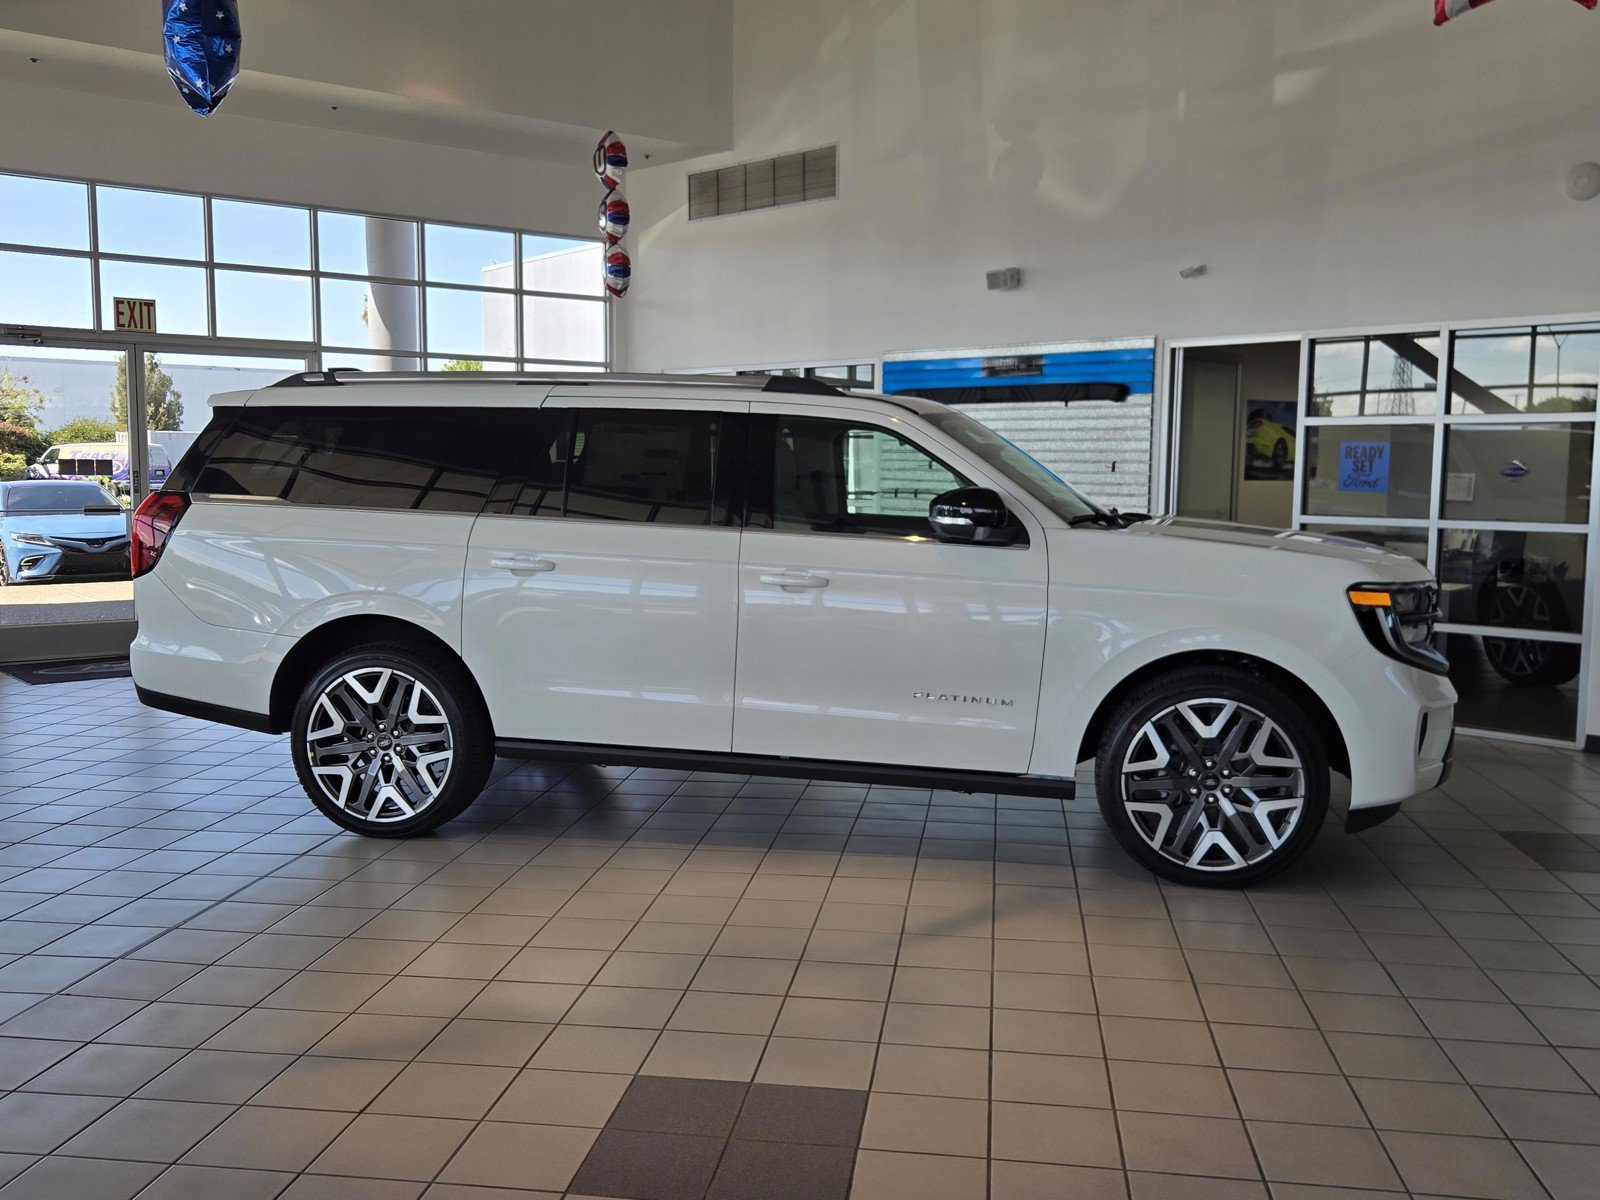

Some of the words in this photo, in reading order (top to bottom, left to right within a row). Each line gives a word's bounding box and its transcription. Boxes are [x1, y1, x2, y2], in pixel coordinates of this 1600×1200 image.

[115, 299, 154, 330] EXIT
[1344, 445, 1385, 460] READY
[1352, 459, 1375, 473] SET
[1343, 472, 1384, 488] Ford
[913, 691, 1015, 707] PLATINUM
